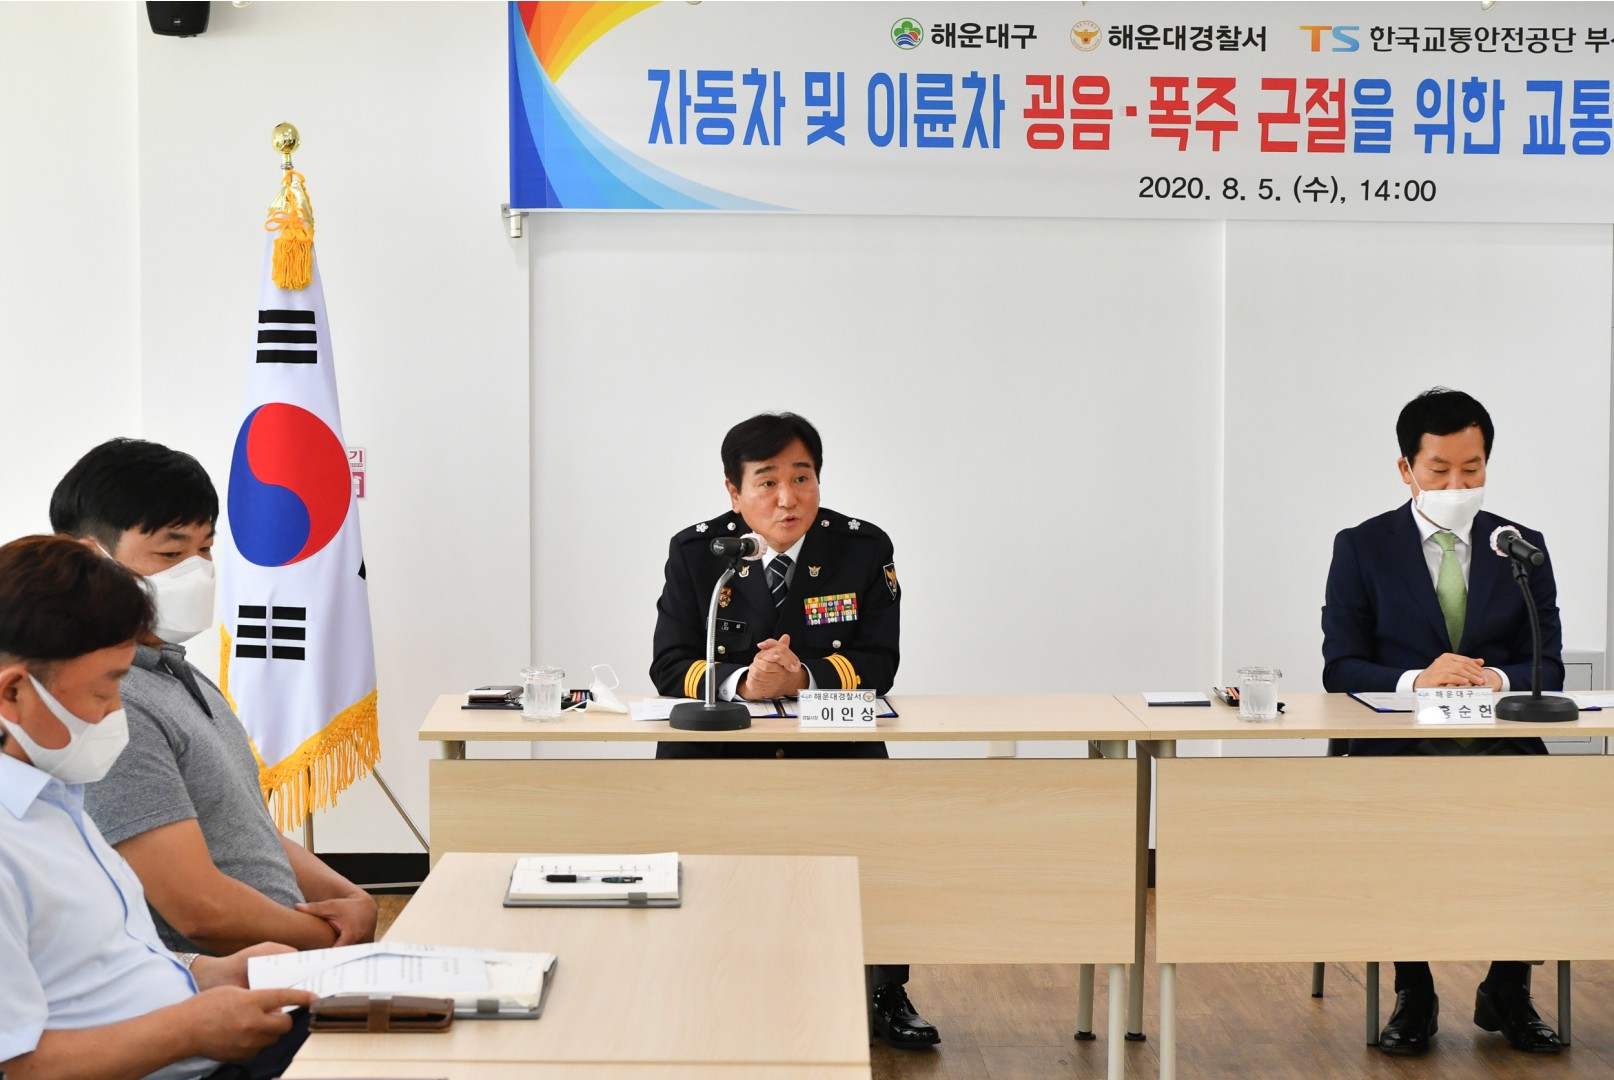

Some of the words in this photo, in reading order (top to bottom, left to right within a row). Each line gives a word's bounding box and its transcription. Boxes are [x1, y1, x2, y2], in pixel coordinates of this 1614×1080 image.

[930, 22, 1038, 50] 해운대구
[1107, 24, 1268, 52] 해운대경찰서
[1299, 25, 1360, 53] TS
[1369, 25, 1577, 54] 한국교통안전공단
[1584, 27, 1614, 53] 부
[647, 67, 786, 147] 자동차
[804, 71, 846, 147] 및
[867, 70, 1006, 149] 이륜차
[1258, 76, 1395, 155] 근절을
[1413, 76, 1506, 156] 위한
[1138, 176, 1211, 201] 2020.
[1222, 177, 1246, 202] 8.
[1258, 178, 1281, 203] 5.
[1293, 175, 1347, 205] (수),
[1360, 179, 1437, 203] 14:00
[814, 692, 861, 700] 해운대경찰서
[1435, 690, 1474, 698] 해운대구
